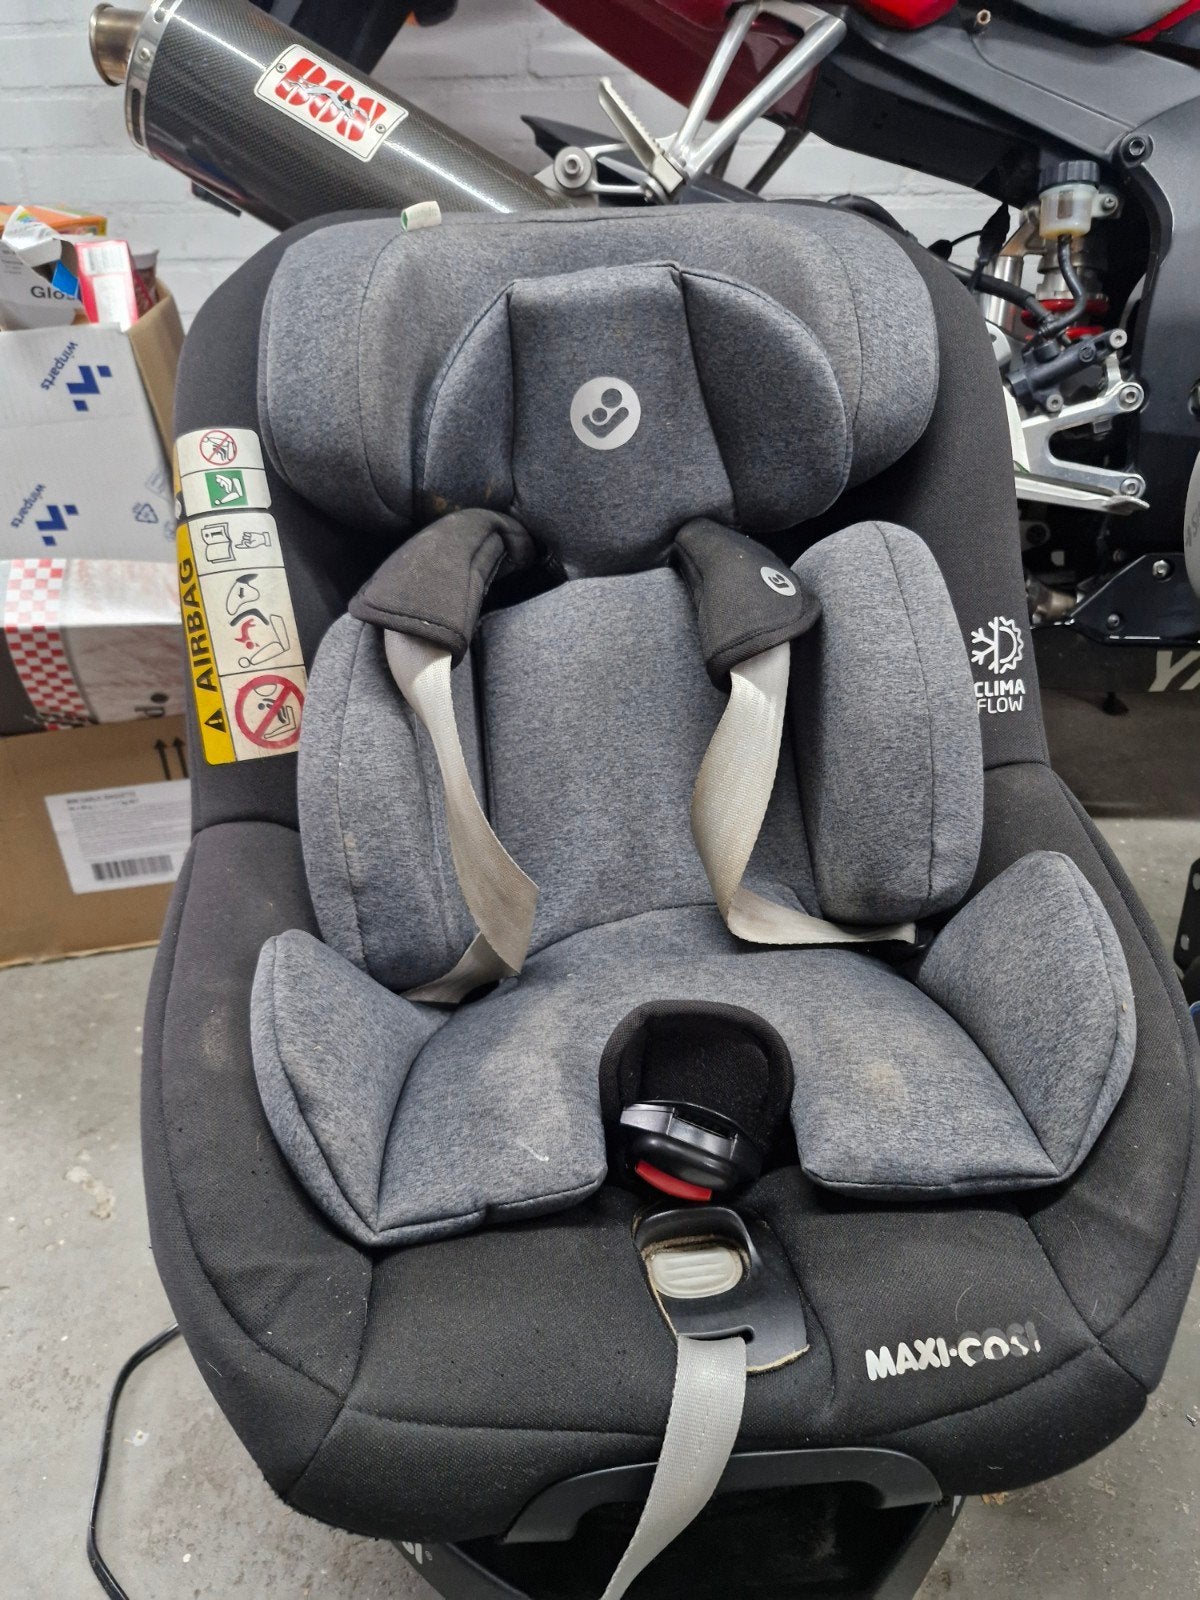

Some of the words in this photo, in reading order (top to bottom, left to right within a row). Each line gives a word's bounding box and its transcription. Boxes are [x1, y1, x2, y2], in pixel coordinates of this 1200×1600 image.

[40, 341, 78, 391] winparts
[11, 484, 46, 529] winparts
[179, 557, 218, 693] AIRBAG
[973, 679, 1026, 698] CLIMA
[976, 696, 1023, 714] FLOW
